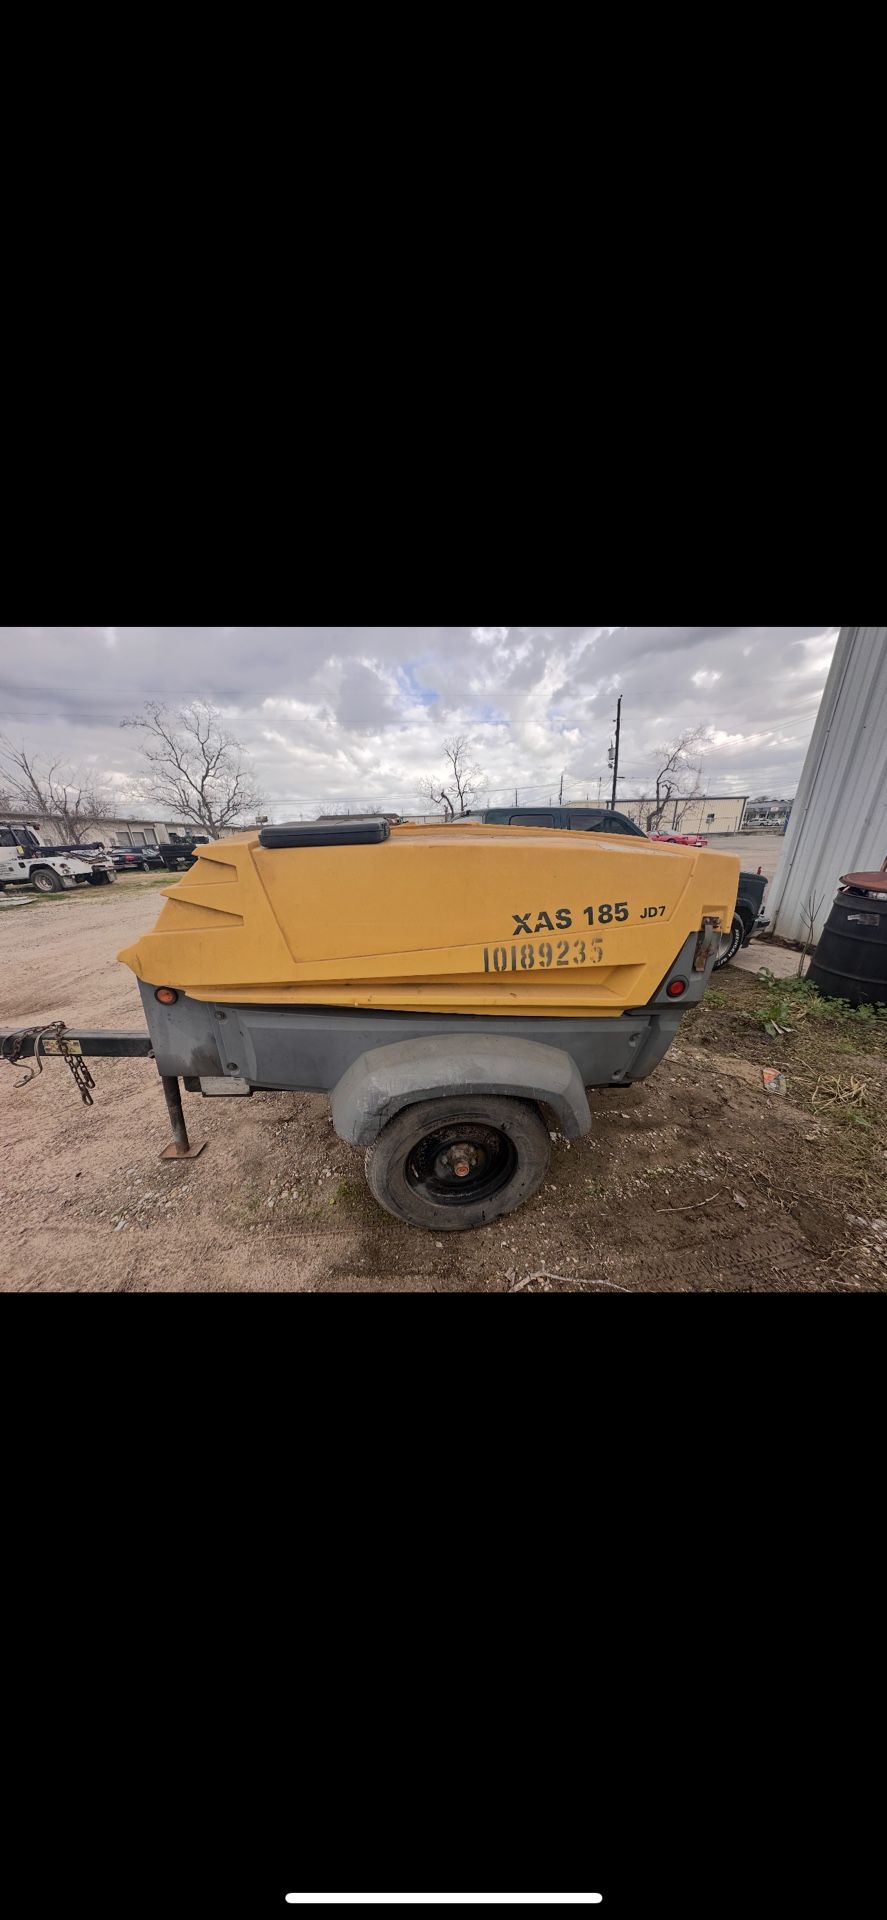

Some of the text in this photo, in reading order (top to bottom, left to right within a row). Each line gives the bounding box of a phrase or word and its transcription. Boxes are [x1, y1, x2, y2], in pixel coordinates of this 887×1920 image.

[512, 901, 666, 936] XAS 185 JD7
[483, 936, 604, 973] 10189235
